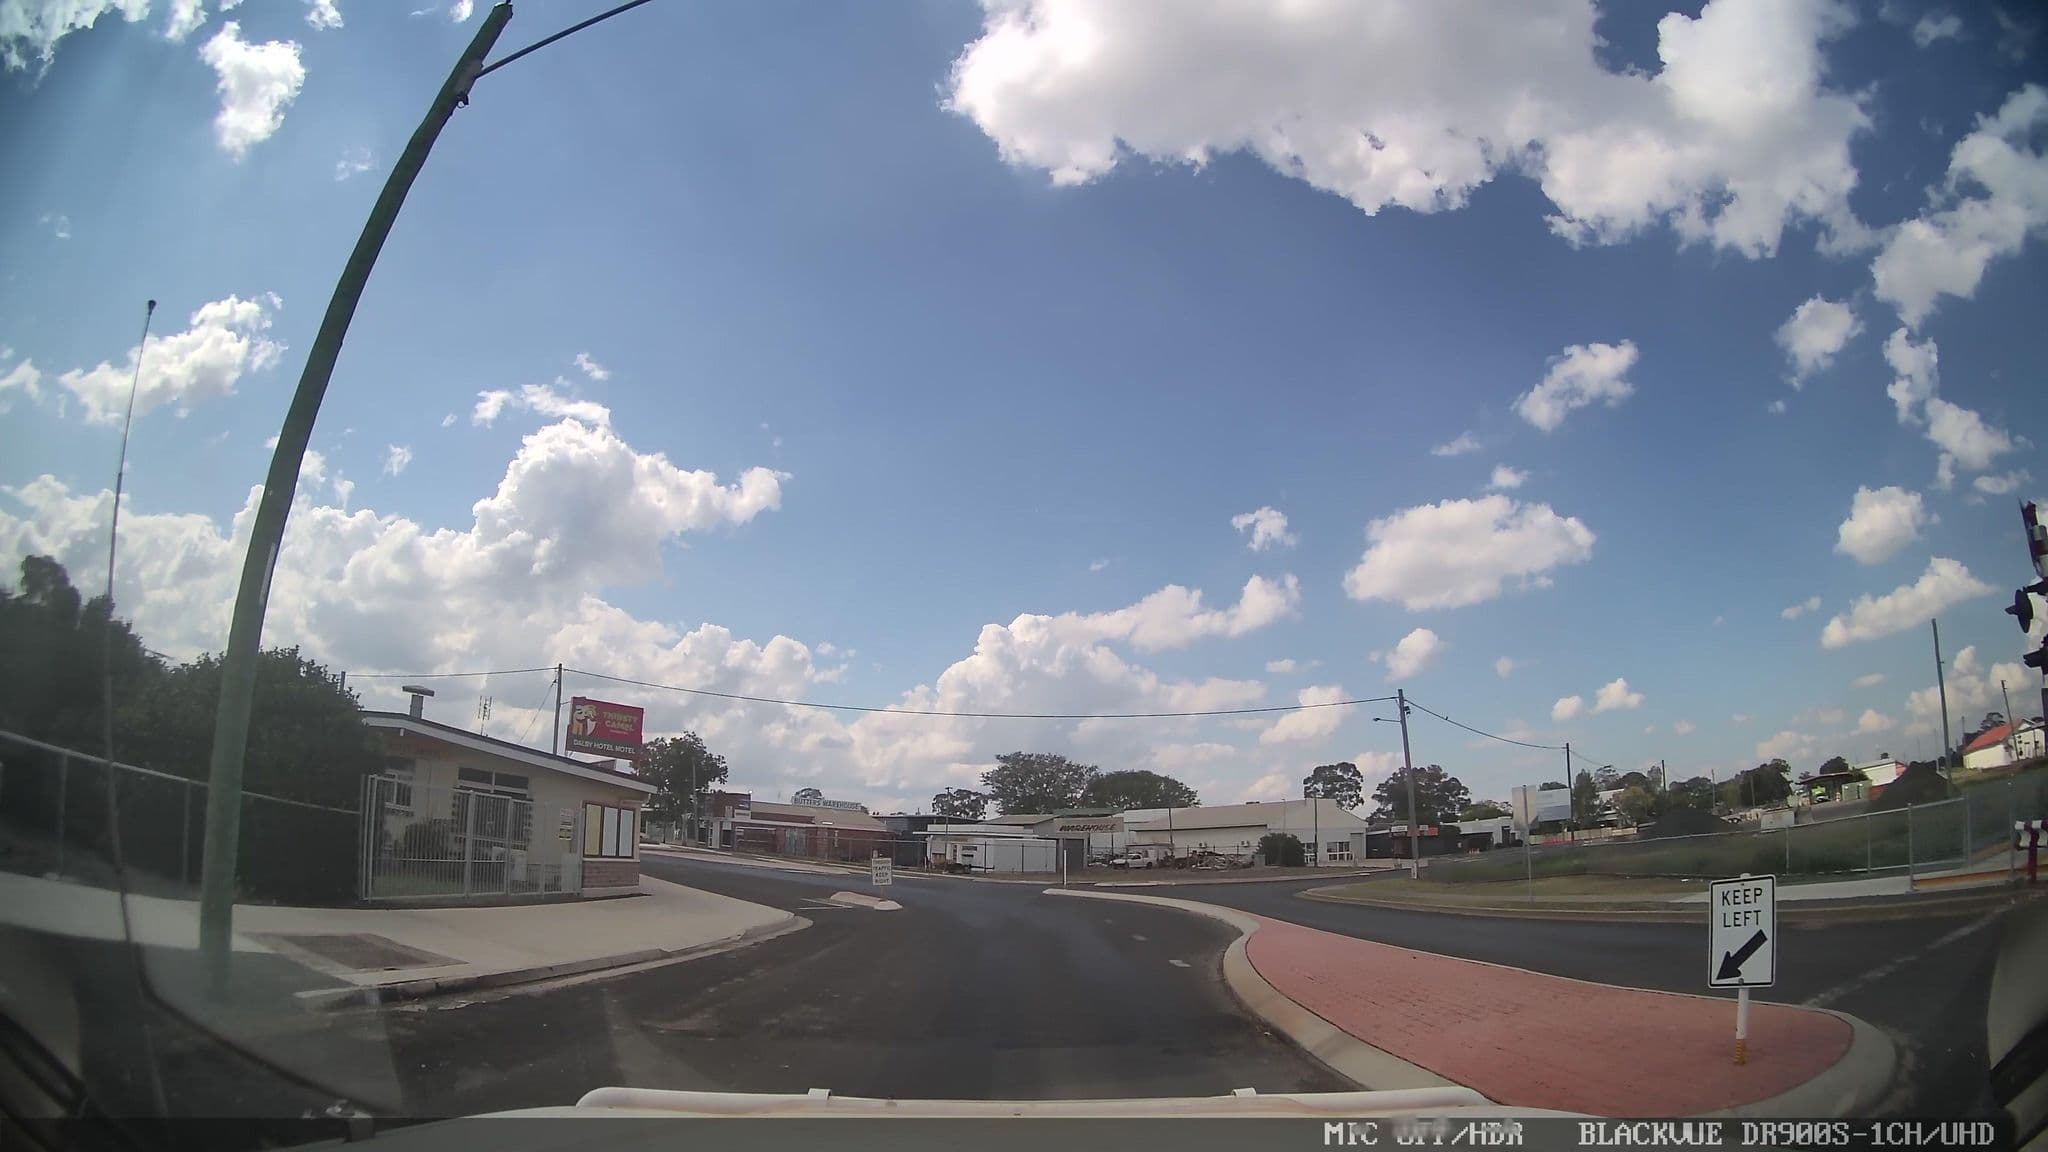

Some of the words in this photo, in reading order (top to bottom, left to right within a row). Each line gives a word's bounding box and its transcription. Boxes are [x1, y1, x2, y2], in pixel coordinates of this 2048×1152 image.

[573, 739, 593, 748] DALBY
[593, 742, 614, 751] HOTEL
[615, 745, 636, 754] MOTEL
[822, 799, 862, 809] WAREHOUSE
[1059, 823, 1117, 832] WAREHOUSE
[1721, 887, 1763, 906] KEEP
[1723, 910, 1762, 928] LEFT
